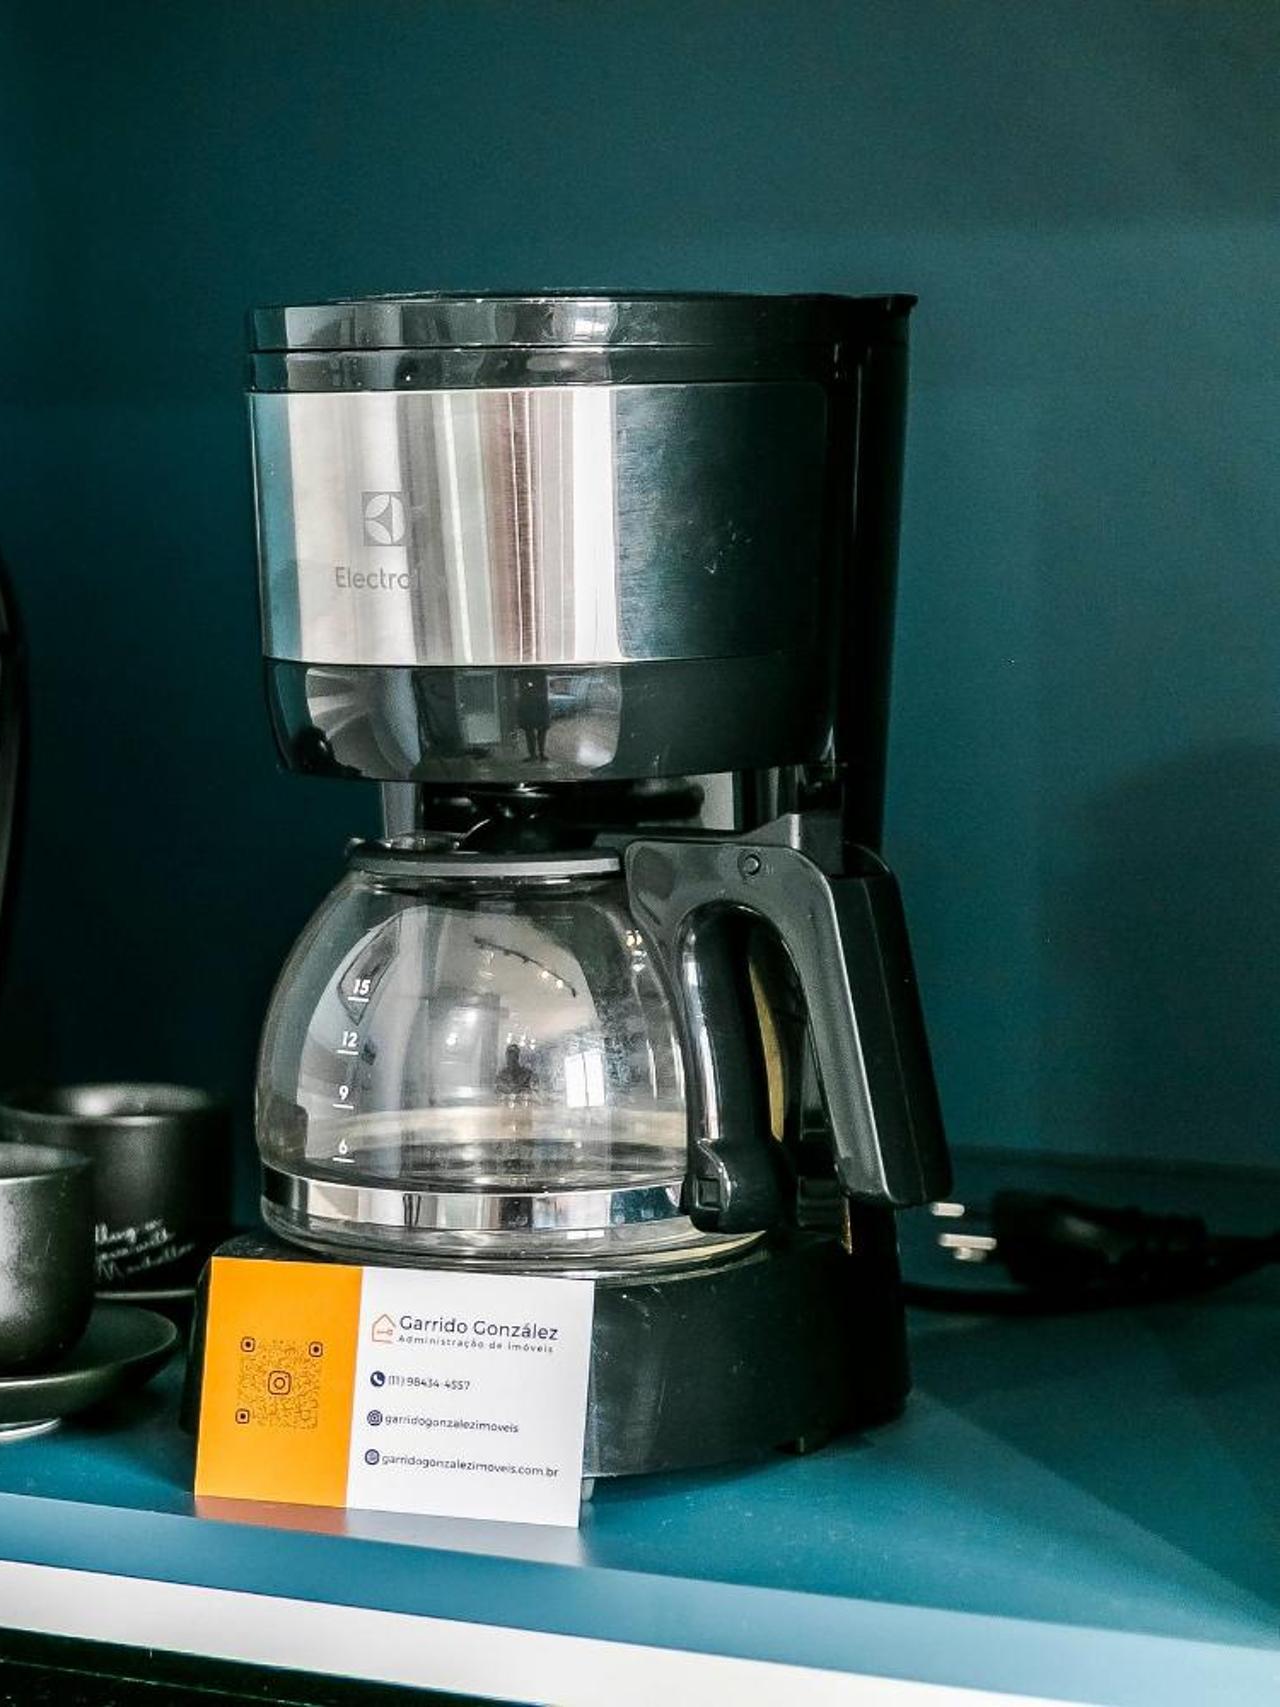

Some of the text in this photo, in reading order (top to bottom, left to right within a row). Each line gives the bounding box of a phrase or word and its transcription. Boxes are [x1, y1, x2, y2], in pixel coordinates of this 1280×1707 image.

[353, 979, 371, 995] 15
[342, 1031, 358, 1047] 12
[339, 1085, 349, 1100] 9
[338, 1139, 349, 1154] 6
[399, 1315, 559, 1341] Garrido González
[398, 1335, 484, 1350] Administração
[489, 1341, 503, 1350] de
[385, 1415, 519, 1434] garridogonzalezimoveis
[382, 1454, 559, 1478] garridogonzalezimoveis.com.br
